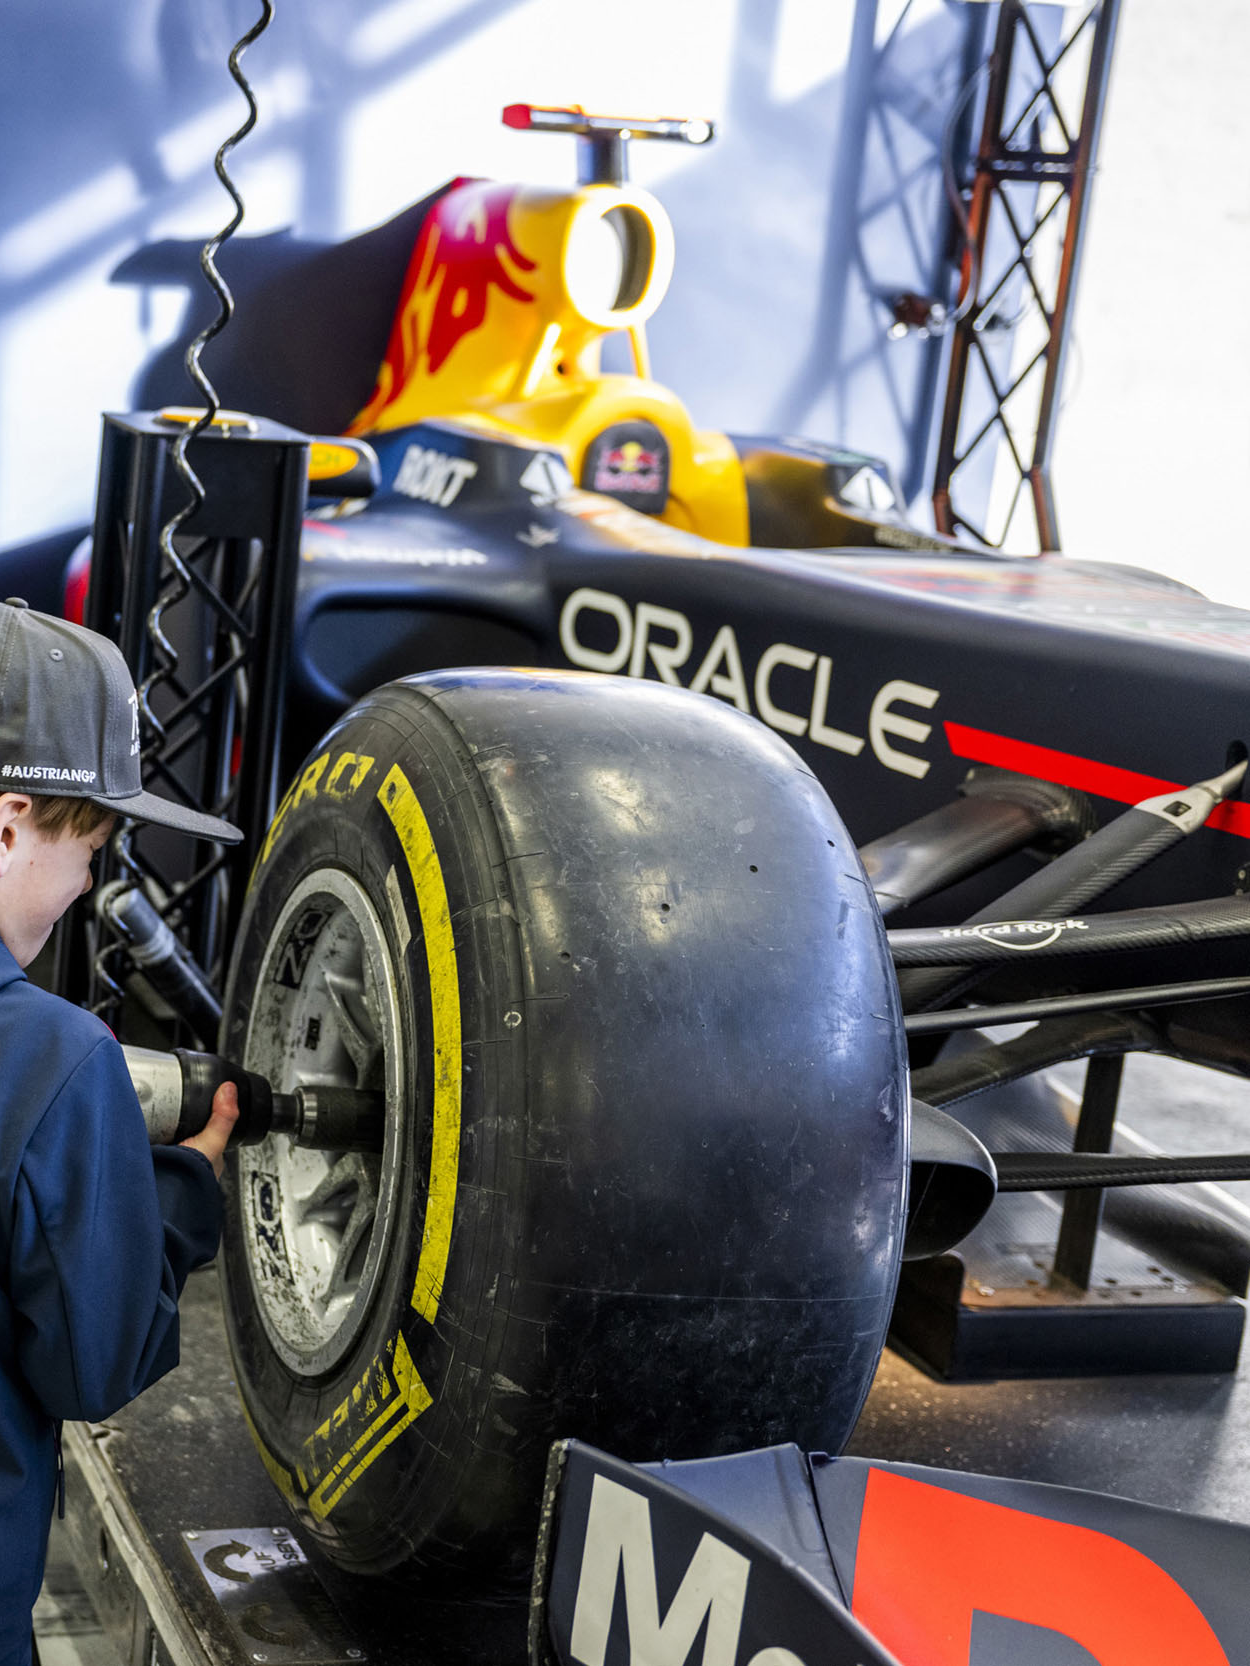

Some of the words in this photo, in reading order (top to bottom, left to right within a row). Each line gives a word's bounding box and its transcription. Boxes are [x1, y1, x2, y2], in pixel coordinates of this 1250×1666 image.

[559, 586, 941, 780] ORACLE
[1, 764, 97, 783] #AUSTRIANGP
[939, 924, 1011, 938] Hard
[1014, 919, 1090, 934] Rock
[570, 1472, 808, 1666] M
